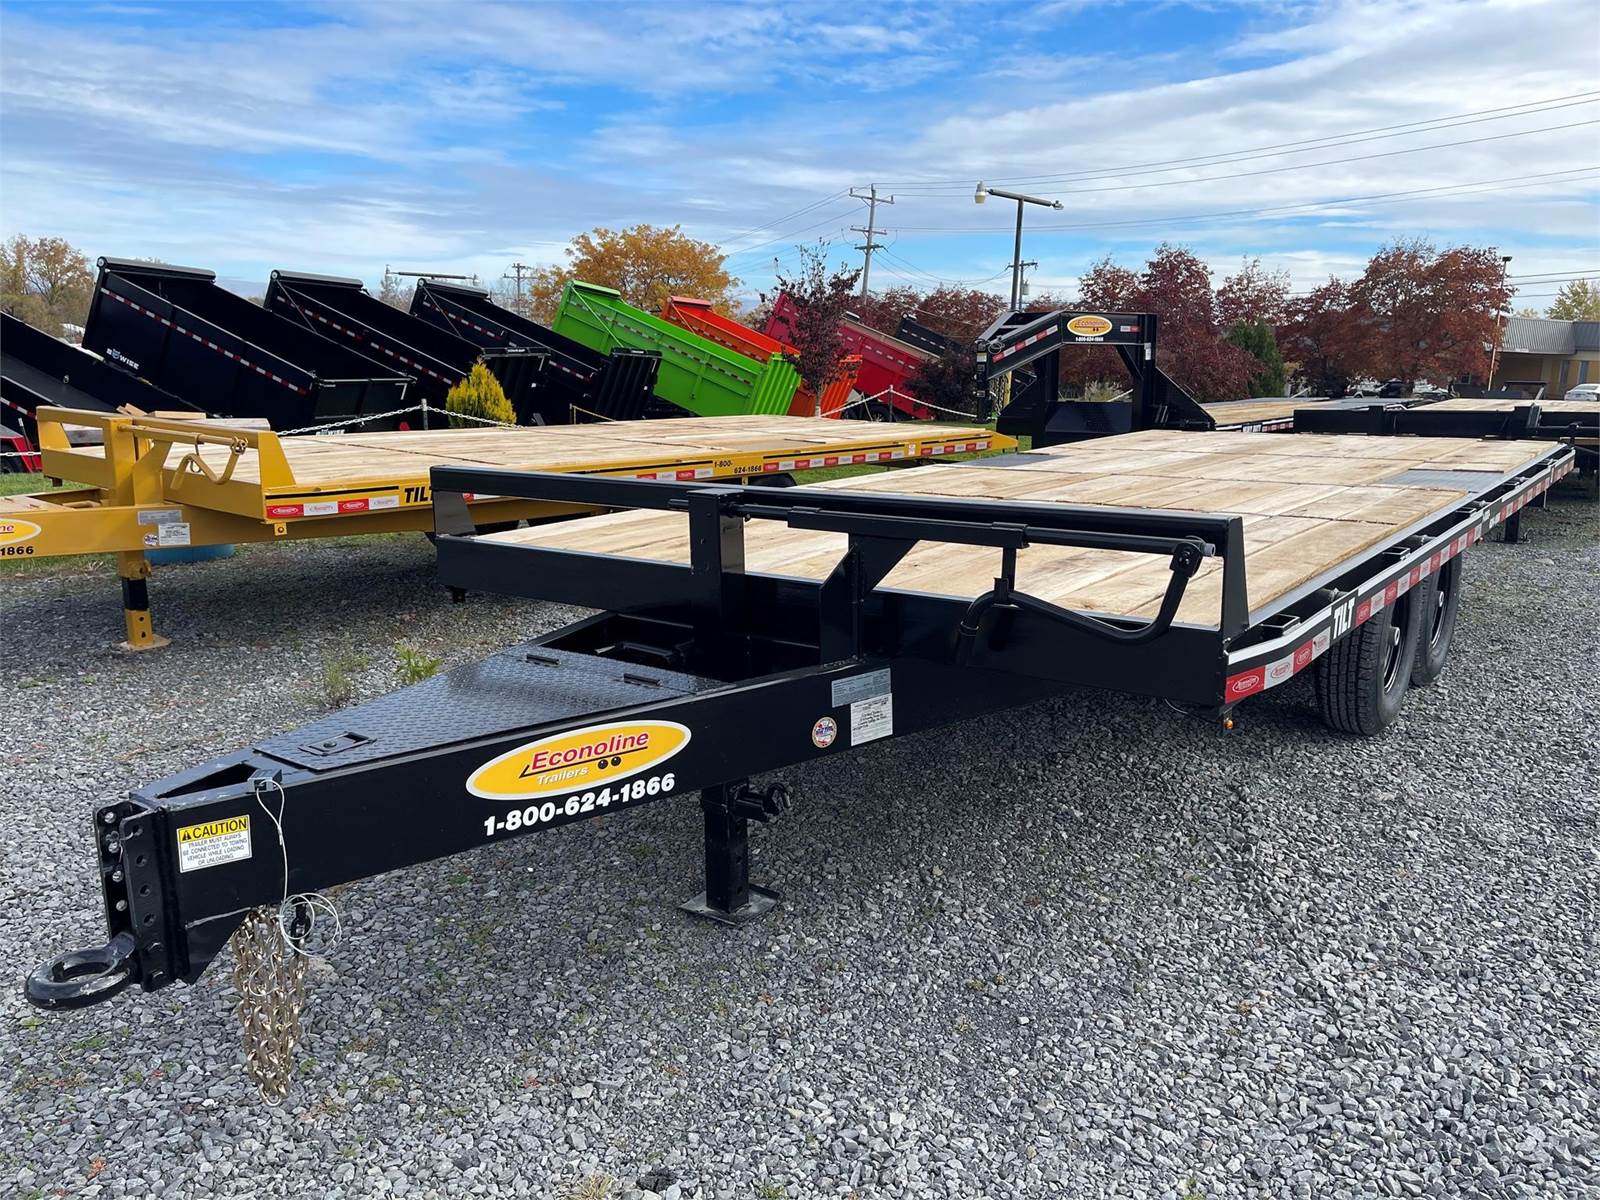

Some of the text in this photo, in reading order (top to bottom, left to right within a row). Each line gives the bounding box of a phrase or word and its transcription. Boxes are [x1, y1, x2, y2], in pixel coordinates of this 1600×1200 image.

[1333, 597, 1356, 639] TILT
[531, 732, 649, 771] Econoline
[537, 766, 589, 785] Trailers
[484, 773, 676, 836] 1-800-624-1866
[192, 818, 247, 839] CAUTION
[188, 840, 208, 848] TRAILER
[224, 833, 242, 841] ALWAYS
[191, 844, 220, 855] CONNECTED
[229, 838, 248, 846] TOWING
[187, 853, 207, 861] VEHICLE
[224, 845, 245, 854] LOADING
